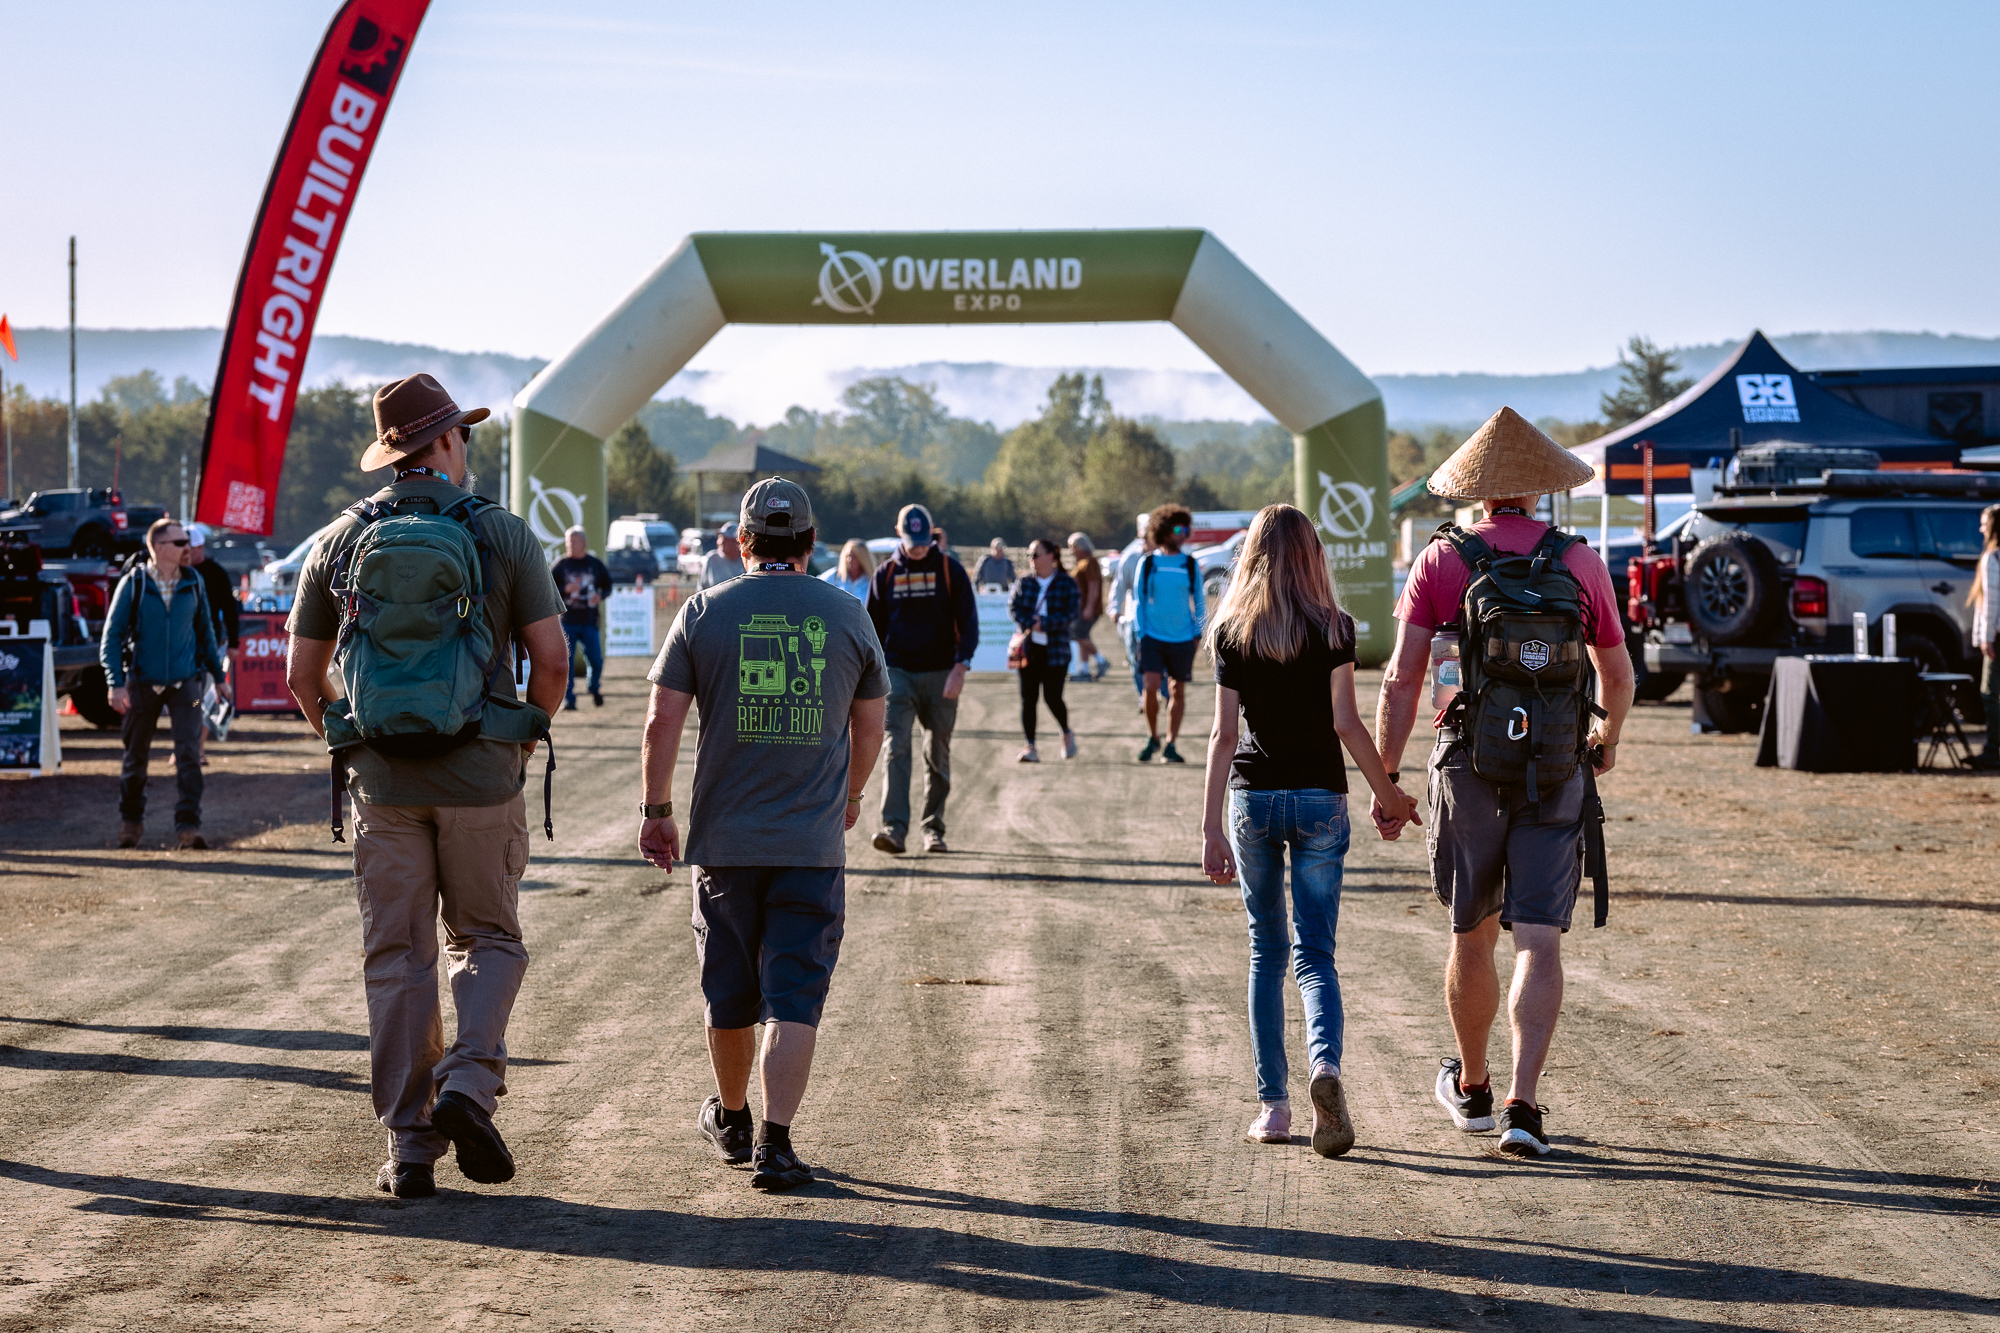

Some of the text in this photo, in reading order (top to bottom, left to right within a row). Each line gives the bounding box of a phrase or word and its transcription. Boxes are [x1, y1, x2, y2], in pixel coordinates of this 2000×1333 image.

[249, 82, 377, 422] BUILTRIGHT
[892, 256, 1083, 290] OVERLAND
[953, 295, 1022, 312] EXPO
[1325, 542, 1388, 559] ERLAND
[737, 697, 824, 706] CAROLINA
[736, 705, 825, 734] RELIC RUN
